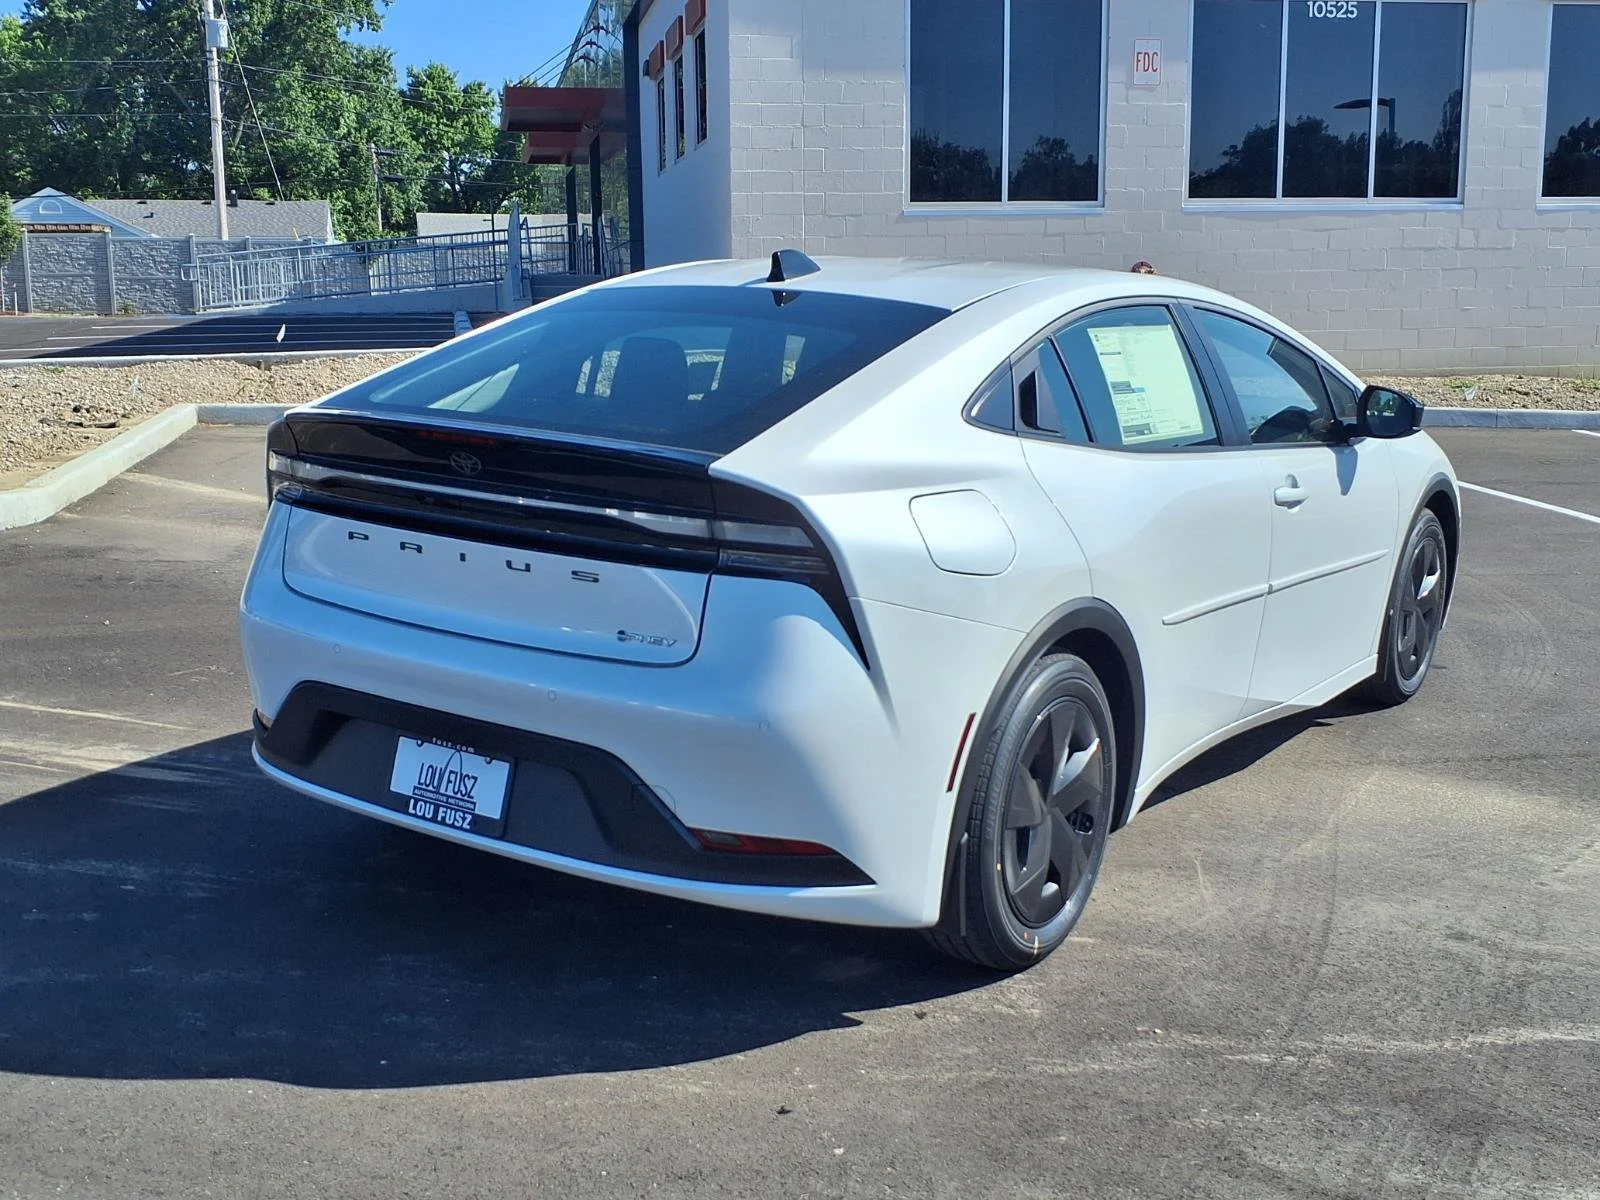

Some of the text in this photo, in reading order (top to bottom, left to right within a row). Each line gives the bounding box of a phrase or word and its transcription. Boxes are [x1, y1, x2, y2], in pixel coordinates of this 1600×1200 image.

[1307, 0, 1358, 19] 10525
[1135, 51, 1159, 73] FDC
[348, 530, 600, 583] PRIUS
[417, 762, 478, 799] LOU FUSZ
[414, 788, 448, 802] AUTOMOTIVE
[408, 798, 473, 829] LOU FUSZ
